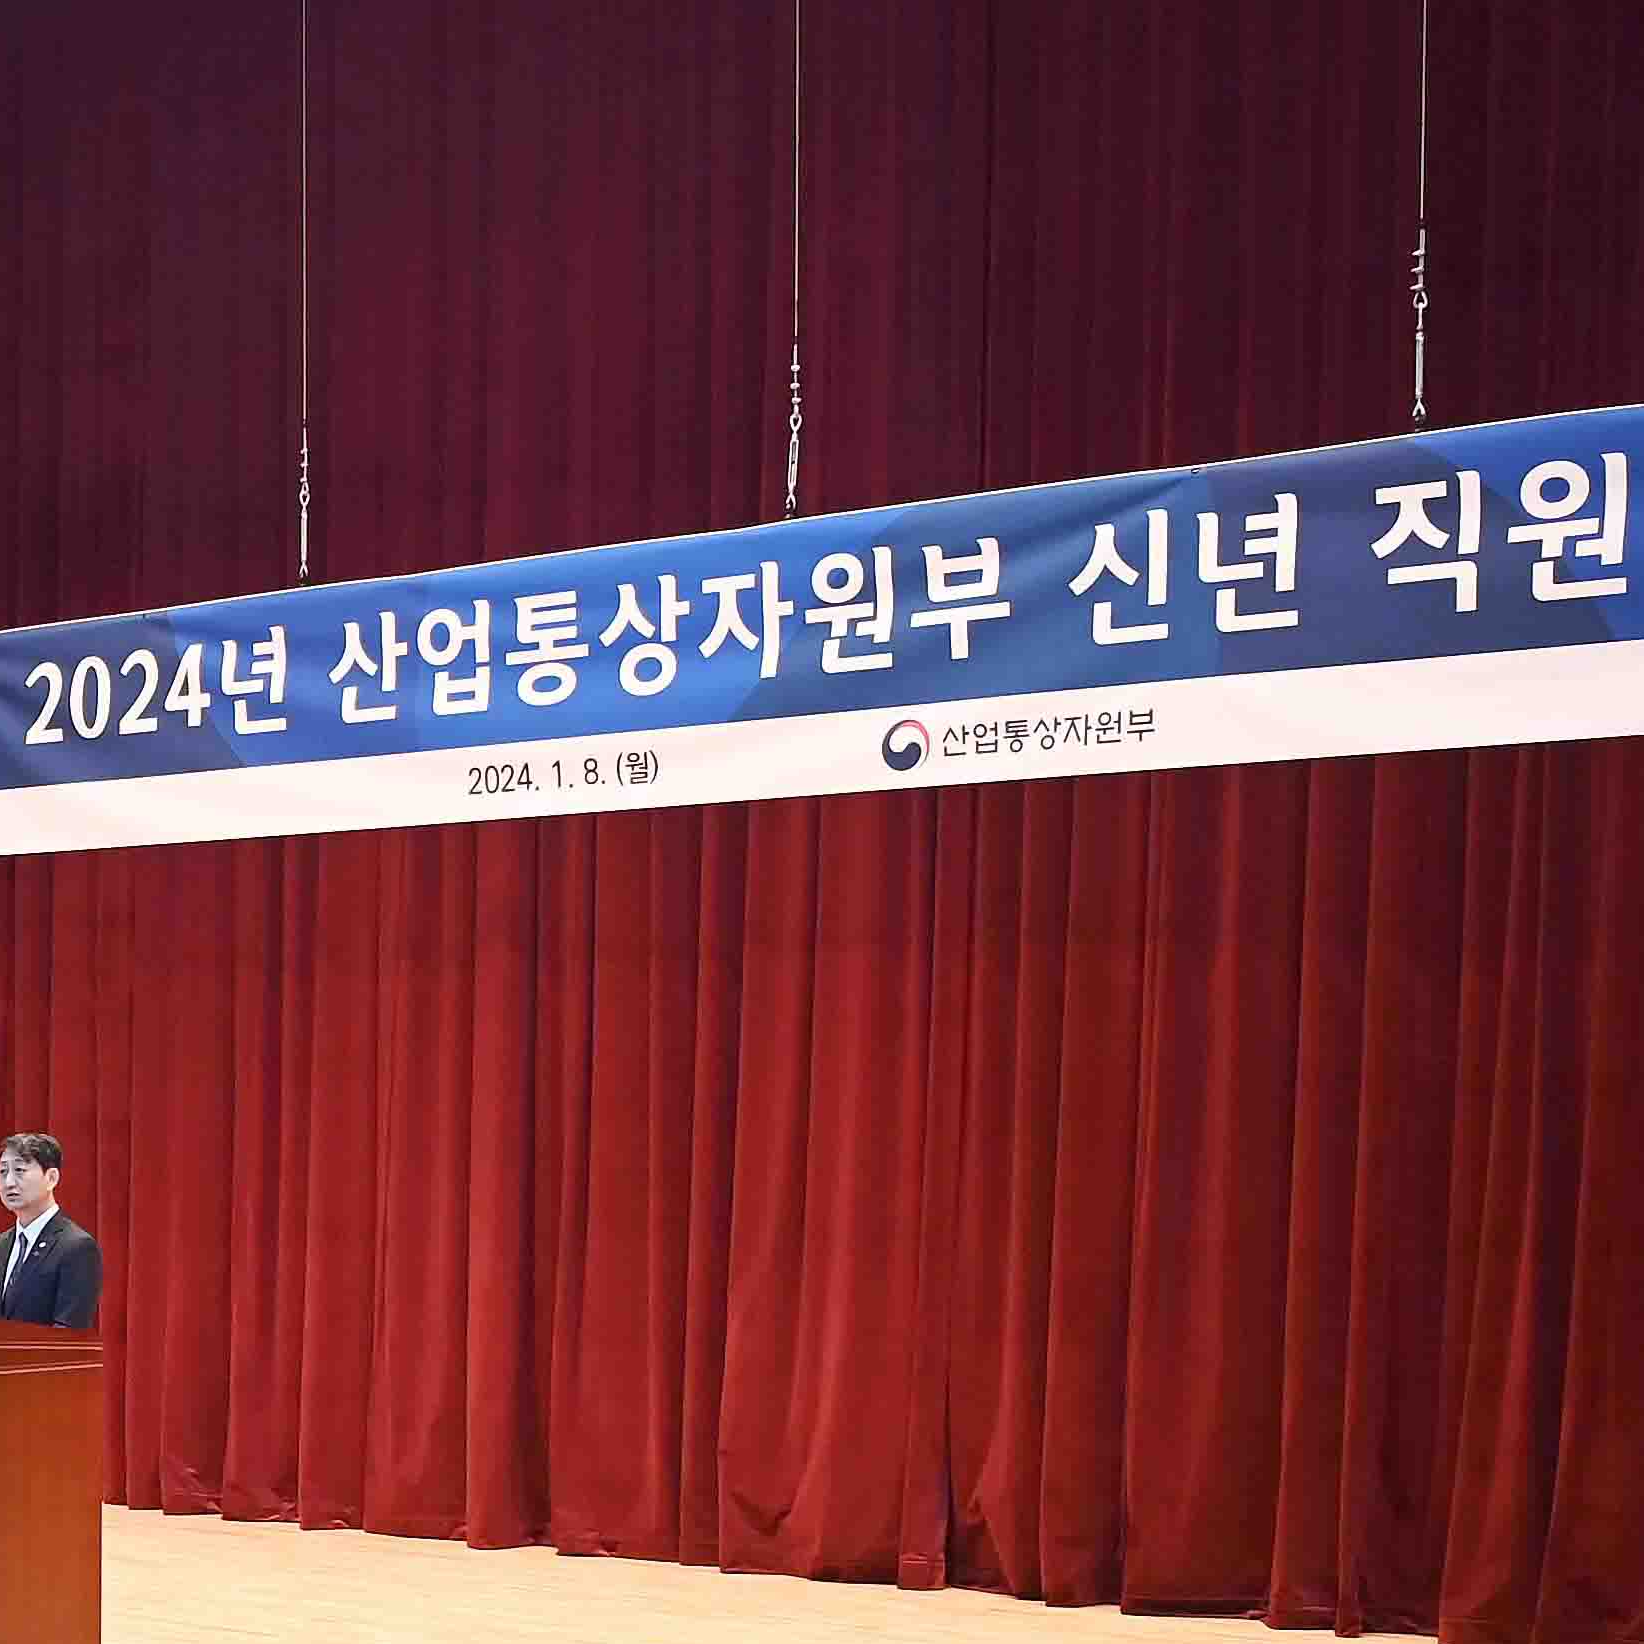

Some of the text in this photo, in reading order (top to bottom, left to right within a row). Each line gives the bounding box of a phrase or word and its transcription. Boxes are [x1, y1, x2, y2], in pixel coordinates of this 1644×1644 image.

[24, 451, 1629, 745] 2024년 산업통상자원부 신년 직원
[942, 709, 1156, 757] 산업통상자원부
[468, 750, 659, 795] 2024. 1. 8. (월)
